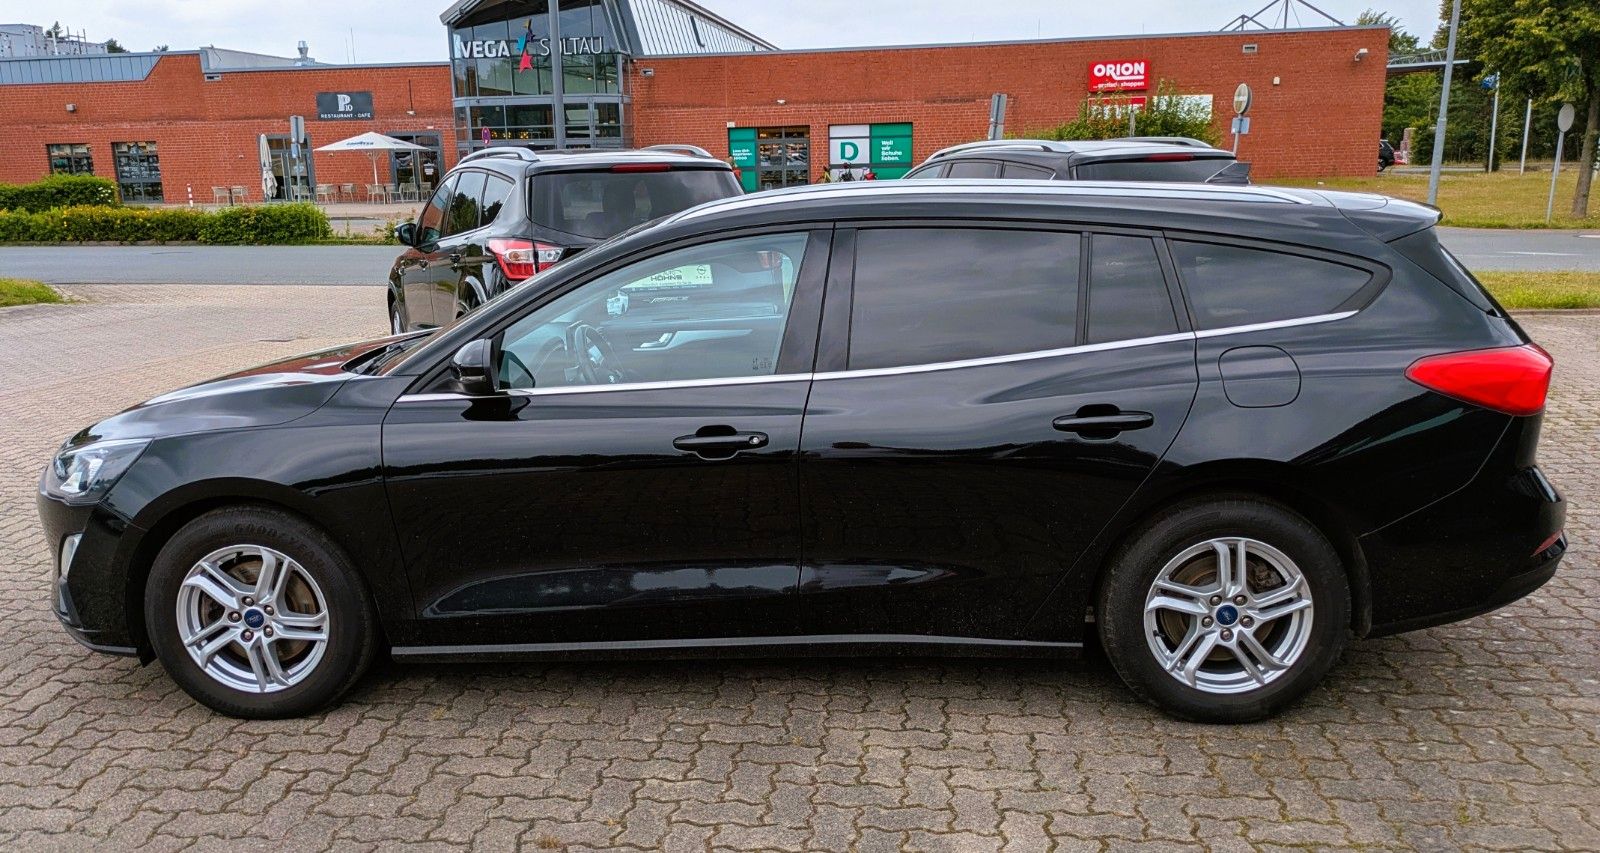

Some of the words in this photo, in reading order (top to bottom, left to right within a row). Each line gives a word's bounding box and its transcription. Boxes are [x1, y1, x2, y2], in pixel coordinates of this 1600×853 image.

[461, 40, 510, 58] VEGA
[540, 37, 603, 56] SLTAU
[1093, 62, 1145, 81] ORION
[840, 142, 859, 161] D
